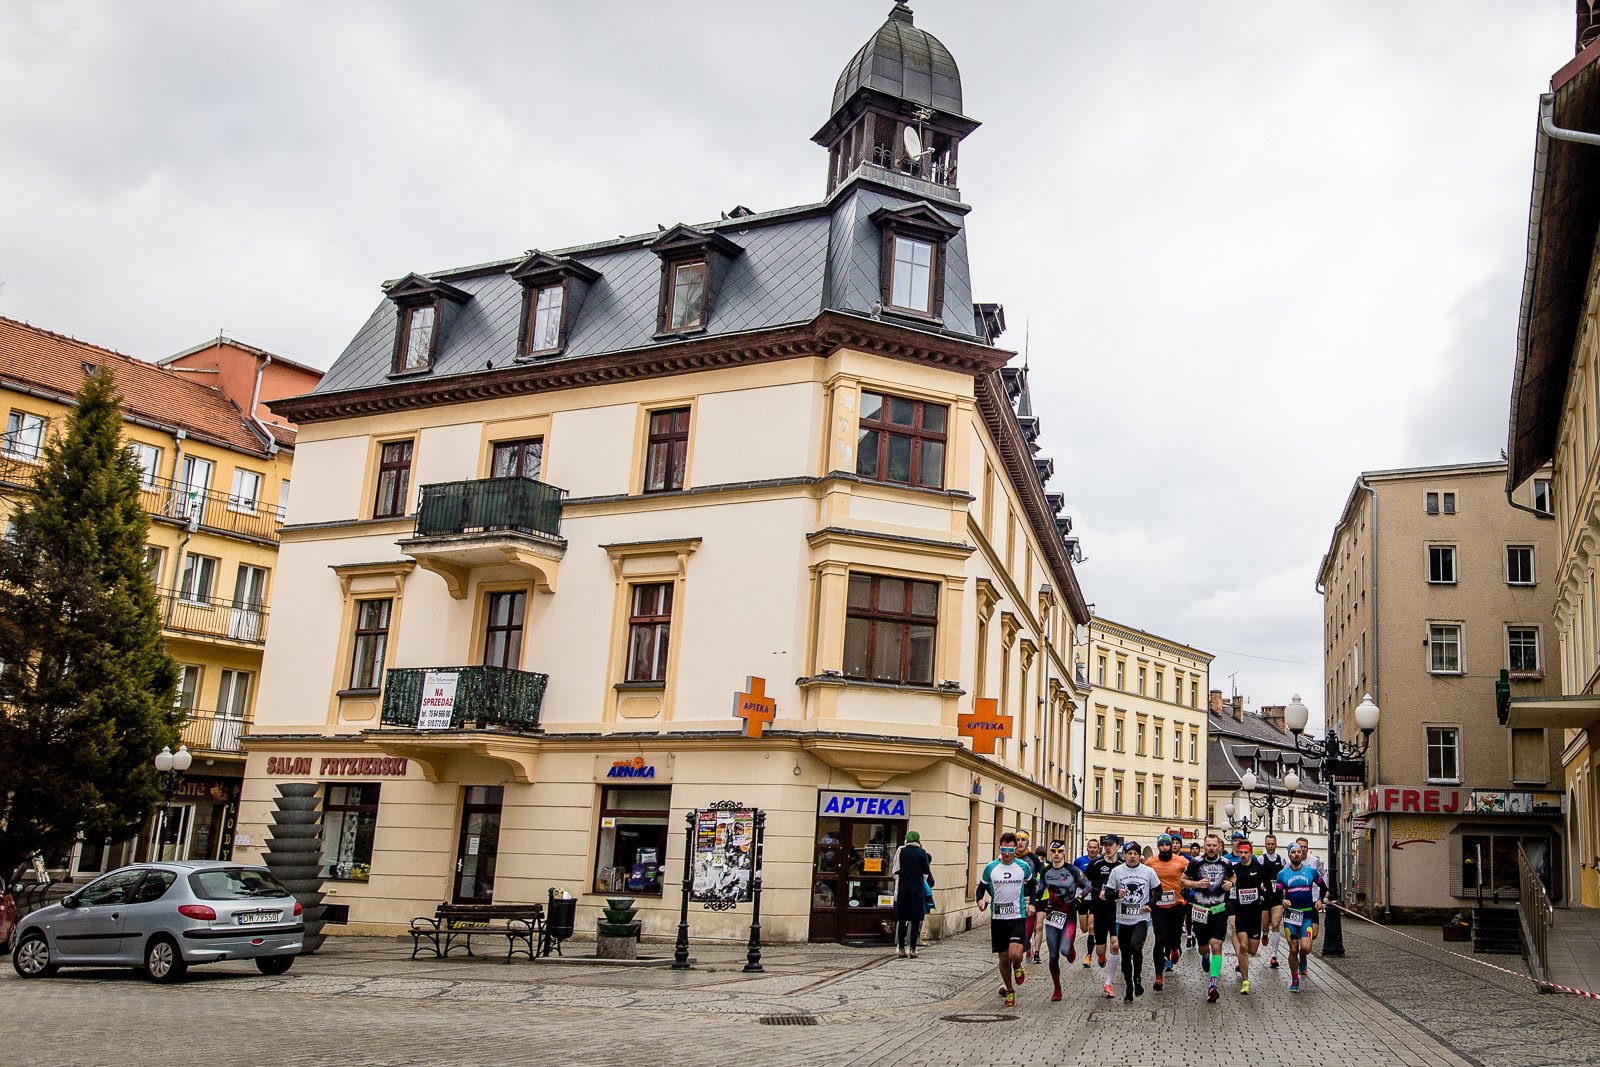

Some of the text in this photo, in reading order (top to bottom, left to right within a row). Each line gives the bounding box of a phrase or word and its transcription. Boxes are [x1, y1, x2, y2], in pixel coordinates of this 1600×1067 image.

[434, 688, 443, 696] NA
[423, 696, 454, 706] SPRZEDAŻ
[744, 702, 768, 713] APTEKA
[966, 722, 1004, 730] APTEKA
[266, 756, 408, 776] SALON FRYZJERSKI
[606, 766, 654, 778] ARNIKA
[1384, 788, 1459, 812] FREJ
[824, 796, 905, 816] APTEKA
[243, 914, 254, 922] DW
